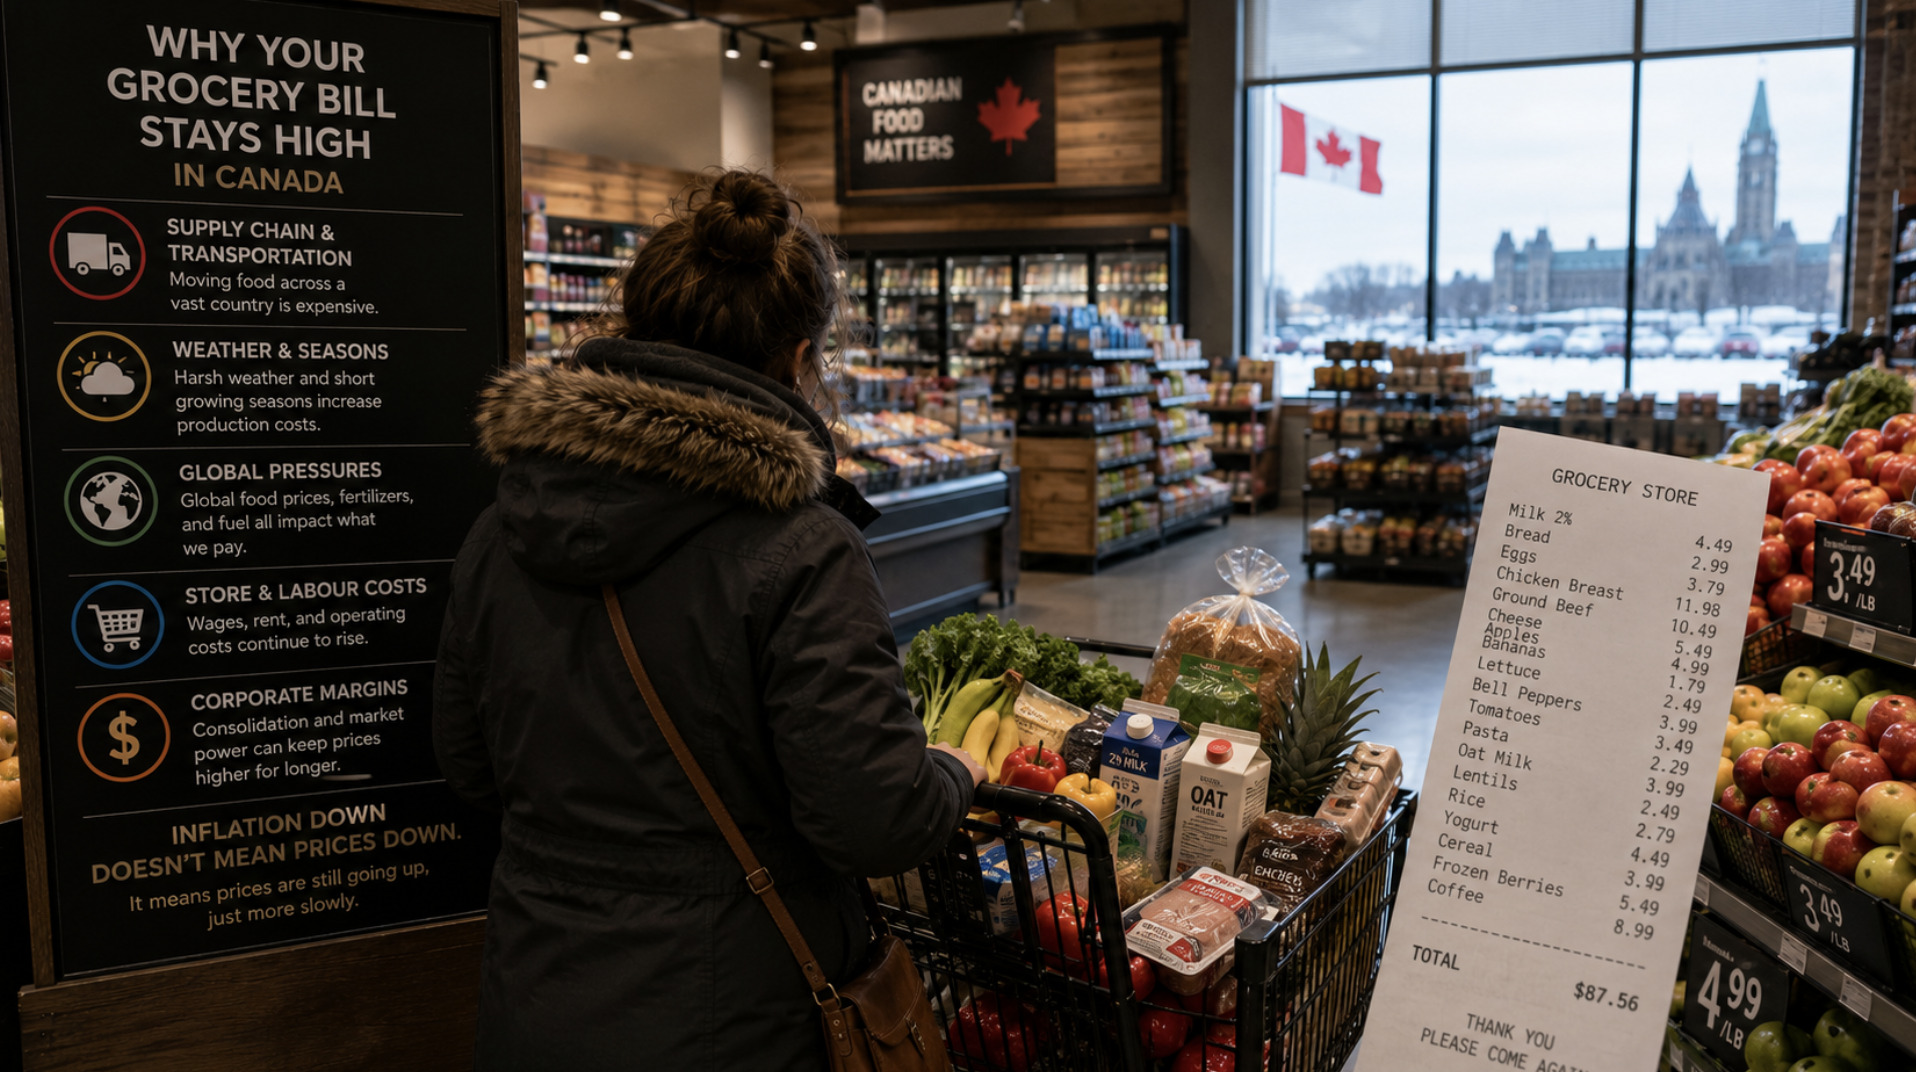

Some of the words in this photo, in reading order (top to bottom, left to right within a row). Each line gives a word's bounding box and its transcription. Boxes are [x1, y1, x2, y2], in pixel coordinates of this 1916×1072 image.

[146, 25, 245, 62] WHY
[256, 35, 365, 73] YOUR
[108, 68, 304, 111] GROCERY
[318, 84, 396, 118] BILL
[863, 78, 962, 106] CANADIAN
[141, 116, 261, 153] STAYS
[276, 124, 370, 159] HIGH
[873, 109, 924, 134] FOOD
[864, 136, 954, 164] MATTERS
[175, 163, 204, 187] IN
[216, 166, 343, 194] CANADA
[168, 218, 244, 237] SUPPLY
[250, 222, 314, 240] CHAIN
[321, 225, 334, 240] &
[168, 245, 351, 266] TRANSPORTATION
[170, 272, 231, 292] Moving
[237, 272, 274, 289] food
[281, 278, 331, 290] across
[337, 280, 345, 290] a
[171, 298, 205, 310] vast
[211, 298, 273, 316] country
[280, 302, 290, 312] is
[296, 300, 378, 316] expensive.
[173, 341, 272, 358] WEATHER
[278, 343, 292, 358] &
[298, 343, 388, 360] SEASONS
[175, 370, 222, 384] Harsh
[228, 370, 294, 385] weather
[300, 370, 329, 385] and
[334, 370, 375, 385] short
[176, 394, 244, 412] growing
[250, 398, 312, 408] seasons
[318, 394, 382, 408] increase
[178, 417, 269, 436] production
[275, 418, 320, 431] costs.
[180, 464, 263, 481] GLOBAL
[270, 462, 382, 479] PRESSURES
[1552, 468, 1632, 494] GROCERY
[1642, 484, 1698, 506] STORE
[181, 492, 234, 507] Global
[240, 491, 277, 506] food
[283, 491, 334, 508] prices,
[339, 489, 413, 504] fertilizers,
[182, 516, 213, 531] and
[218, 515, 249, 530] fuel
[255, 514, 272, 529] all
[278, 514, 332, 531] impact
[337, 512, 376, 526] what
[1509, 503, 1545, 521] Milk
[1554, 510, 1572, 525] 2%
[1696, 536, 1732, 553] 4.49
[183, 544, 208, 555] we
[214, 543, 246, 558] pay.
[1505, 524, 1550, 543] Bread
[1692, 556, 1728, 574] 2.99
[1501, 544, 1536, 564] Eggs
[1688, 578, 1724, 596] 3.79
[186, 586, 252, 604] STORE
[259, 585, 272, 600] &
[279, 581, 358, 599] LABOUR
[365, 578, 426, 595] COSTS
[1496, 565, 1559, 591] Chicken
[1569, 578, 1623, 600] Breast
[1677, 597, 1720, 617] 11.98
[187, 616, 248, 634] Wages,
[254, 613, 290, 628] rent,
[296, 609, 325, 625] and
[330, 606, 405, 626] operating
[1493, 587, 1547, 608] Ground
[1556, 598, 1594, 616] Beef
[1673, 619, 1716, 638] 10.49
[189, 640, 232, 655] costs
[238, 635, 309, 651] continue
[314, 634, 331, 646] to
[337, 631, 368, 645] rise.
[1484, 621, 1540, 645] Apples
[1671, 658, 1709, 676] 4.99
[1487, 608, 1542, 630] Cheese
[1675, 640, 1712, 659] 5.49
[1481, 635, 1545, 659] Bananas
[1670, 675, 1705, 694] 1.79
[192, 686, 313, 710] CORPORATE
[320, 679, 408, 700] MARGINS
[1478, 656, 1540, 680] Lettuce
[1664, 694, 1702, 714] 2.49
[193, 716, 308, 737] Consolidation
[314, 710, 343, 727] and
[350, 707, 404, 724] market
[1472, 677, 1507, 696] Bell
[1518, 686, 1582, 711] Peppers
[1660, 715, 1697, 734] 3.99
[1470, 698, 1540, 726] Tomatoes
[1655, 736, 1693, 754] 3.49
[195, 746, 248, 765] power
[254, 744, 282, 755] can
[288, 738, 327, 753] keep
[333, 733, 381, 752] prices
[1463, 720, 1508, 742] Pasta
[1650, 756, 1689, 776] 2.29
[196, 768, 250, 787] higher
[255, 764, 279, 779] for
[285, 761, 342, 779] longer.
[1459, 743, 1486, 760] Oat
[1494, 750, 1532, 770] Milk
[1646, 778, 1684, 798] 3.99
[1191, 786, 1228, 809] OAT
[1454, 765, 1517, 792] Lentils
[1640, 800, 1680, 820] 2.49
[172, 812, 302, 845] INFLATION
[311, 804, 385, 828] DOWN
[1448, 788, 1485, 808] Rice
[1636, 823, 1675, 844] 2.79
[214, 843, 285, 869] MEAN
[295, 832, 376, 859] PRICES
[384, 823, 461, 848] DOWN.
[1445, 810, 1498, 834] Yogurt
[1631, 847, 1670, 868] 4.49
[1438, 833, 1492, 858] Cereal
[1624, 870, 1664, 891] 3.99
[130, 896, 142, 911] It
[150, 891, 210, 909] means
[217, 882, 272, 904] prices
[278, 879, 306, 892] are
[312, 869, 341, 888] still
[348, 866, 396, 886] going
[403, 863, 428, 878] up,
[1434, 855, 1488, 880] Frozen
[1498, 870, 1564, 897] Berries
[1620, 894, 1659, 916] 5.49
[208, 909, 242, 931] just
[248, 905, 294, 921] more
[301, 893, 358, 914] slowly.
[1428, 878, 1484, 903] Coffee
[1614, 919, 1654, 940] 8.99
[1413, 944, 1460, 970] TOTAL
[1574, 982, 1638, 1011] $87.56
[1421, 1028, 1478, 1056] PLEASE
[1488, 1045, 1528, 1070] COME
[1536, 1059, 1589, 1072] AGA
[1468, 1013, 1515, 1040] THANK
[1526, 1029, 1555, 1050] YOU
